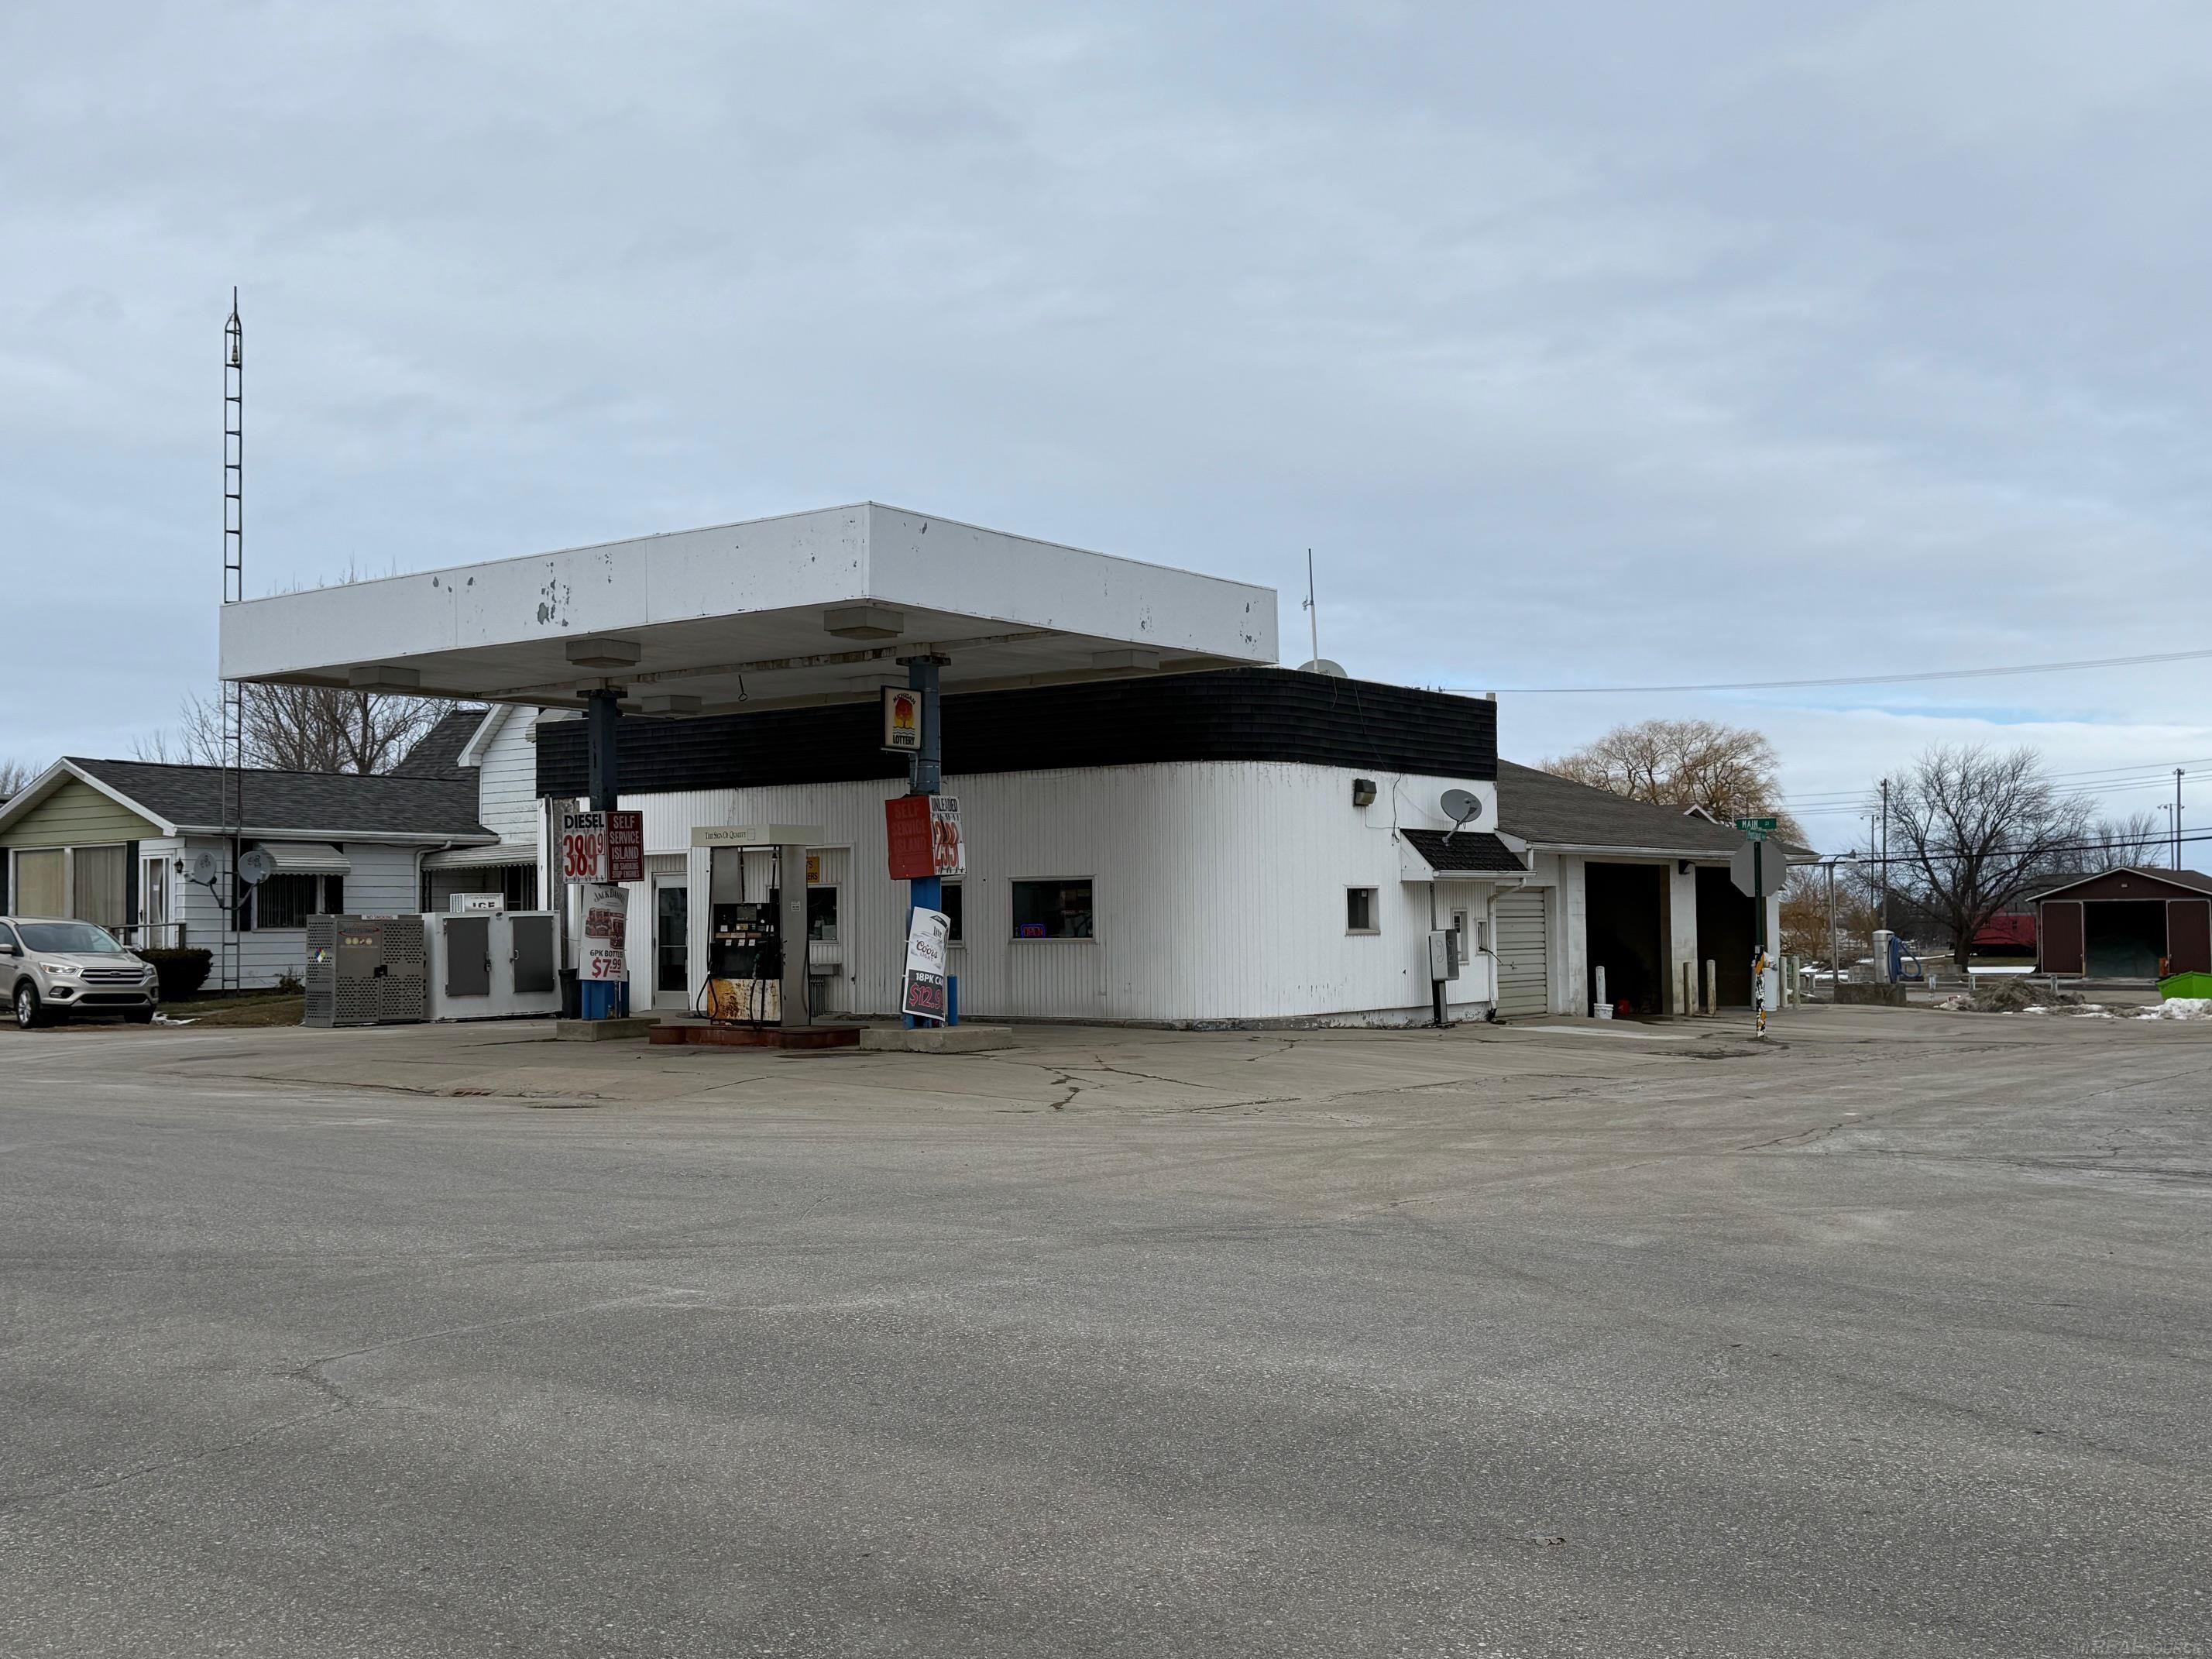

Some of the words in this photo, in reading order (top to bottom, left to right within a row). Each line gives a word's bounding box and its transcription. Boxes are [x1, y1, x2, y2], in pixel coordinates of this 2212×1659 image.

[893, 735, 915, 745] LOTTERY
[931, 798, 958, 812] UNLEADED
[564, 813, 605, 830] DIESEL
[613, 815, 635, 830] SELF
[1742, 819, 1758, 829] MAIN
[610, 830, 640, 845] SERVICE
[713, 831, 723, 840] SIGN
[729, 830, 747, 840] QUALITY
[612, 846, 639, 860] ISLAND
[589, 949, 604, 957] 6PK
[916, 939, 938, 960] Coors
[915, 972, 934, 984] 18PK
